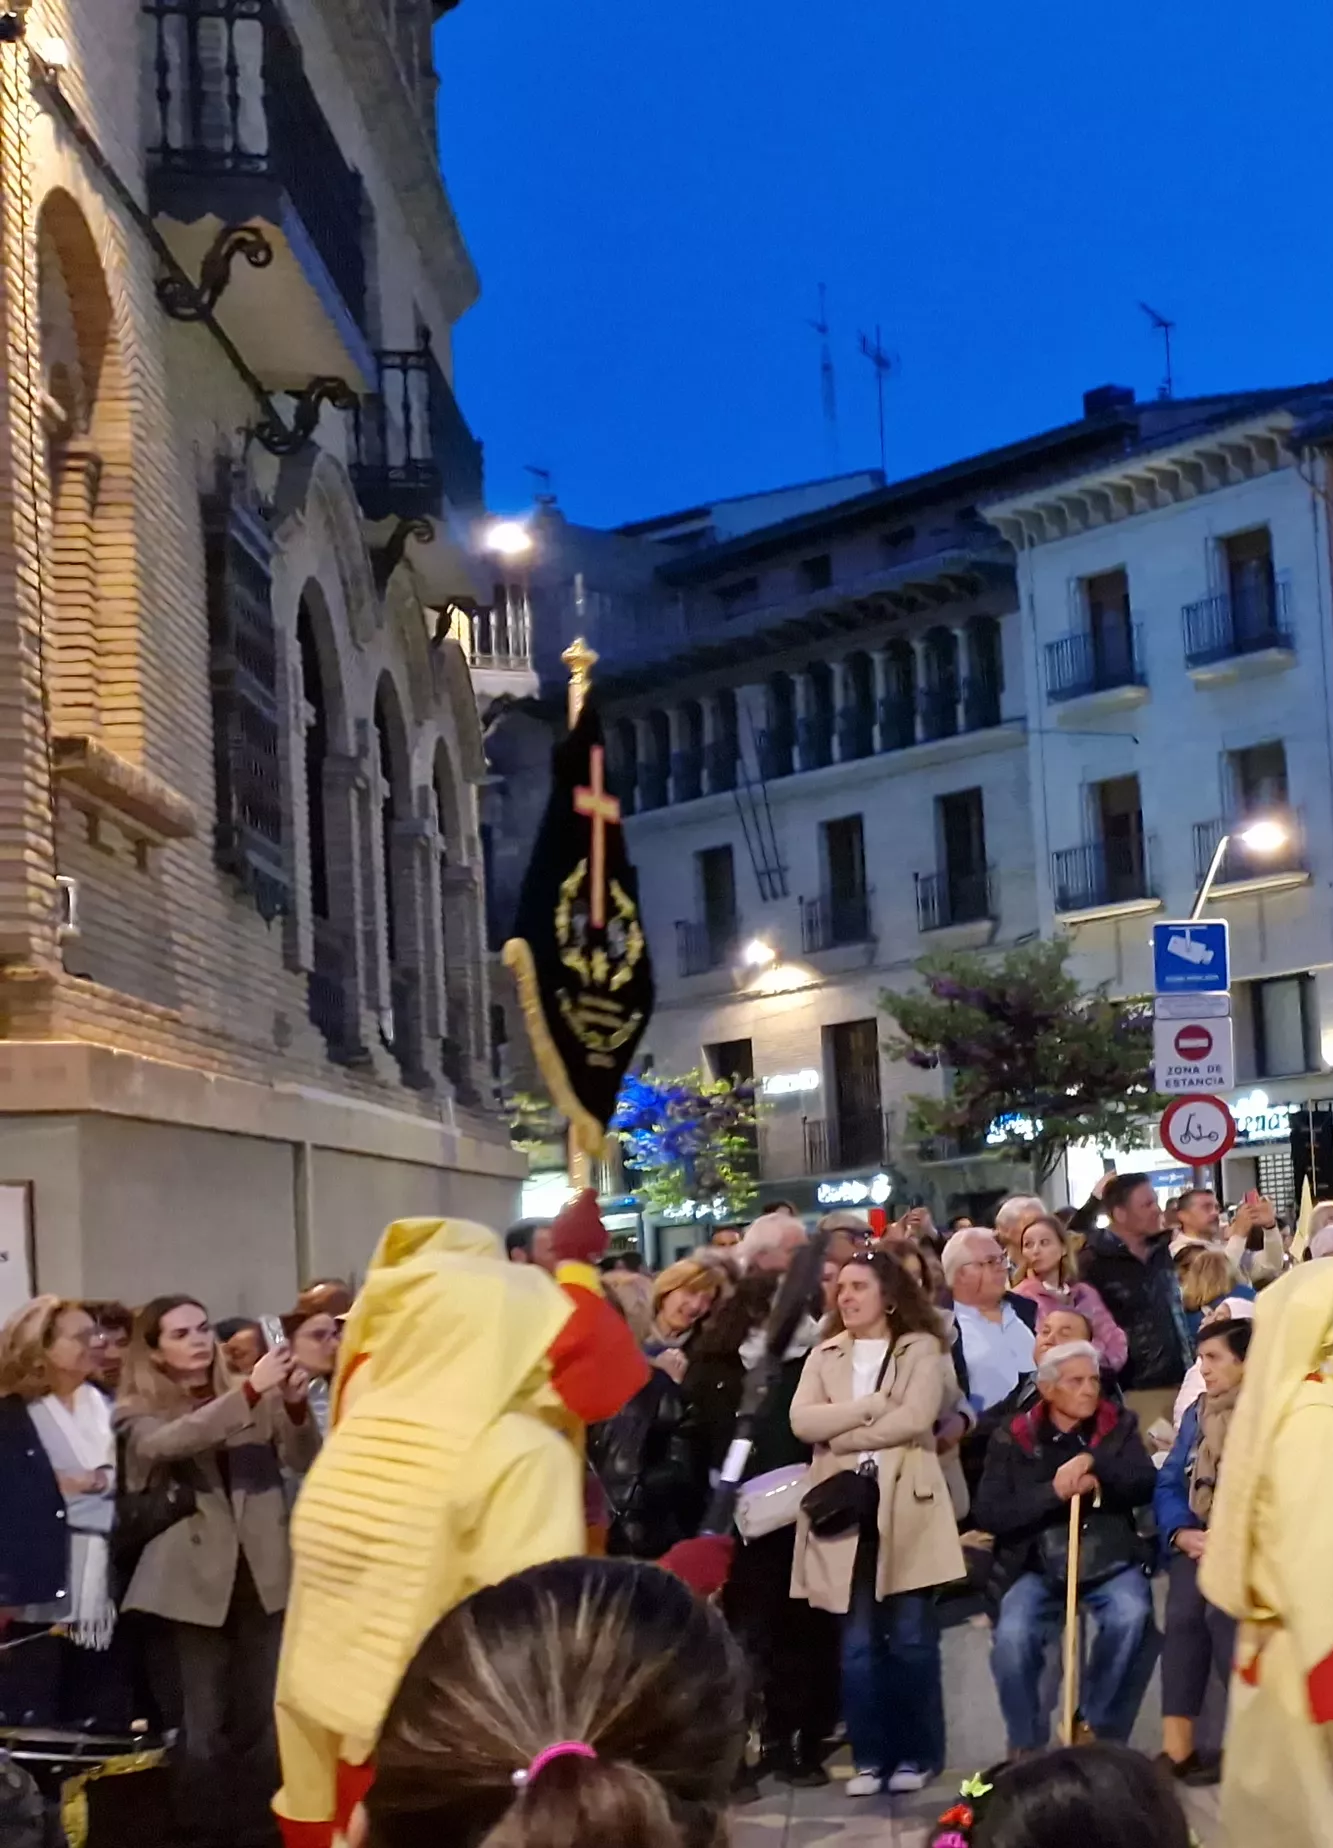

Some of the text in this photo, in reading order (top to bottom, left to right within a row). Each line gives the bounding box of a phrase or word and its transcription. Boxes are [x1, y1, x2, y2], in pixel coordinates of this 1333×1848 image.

[1167, 1064, 1223, 1076] ZONA DE
[1165, 1077, 1225, 1088] ESTANCIA
